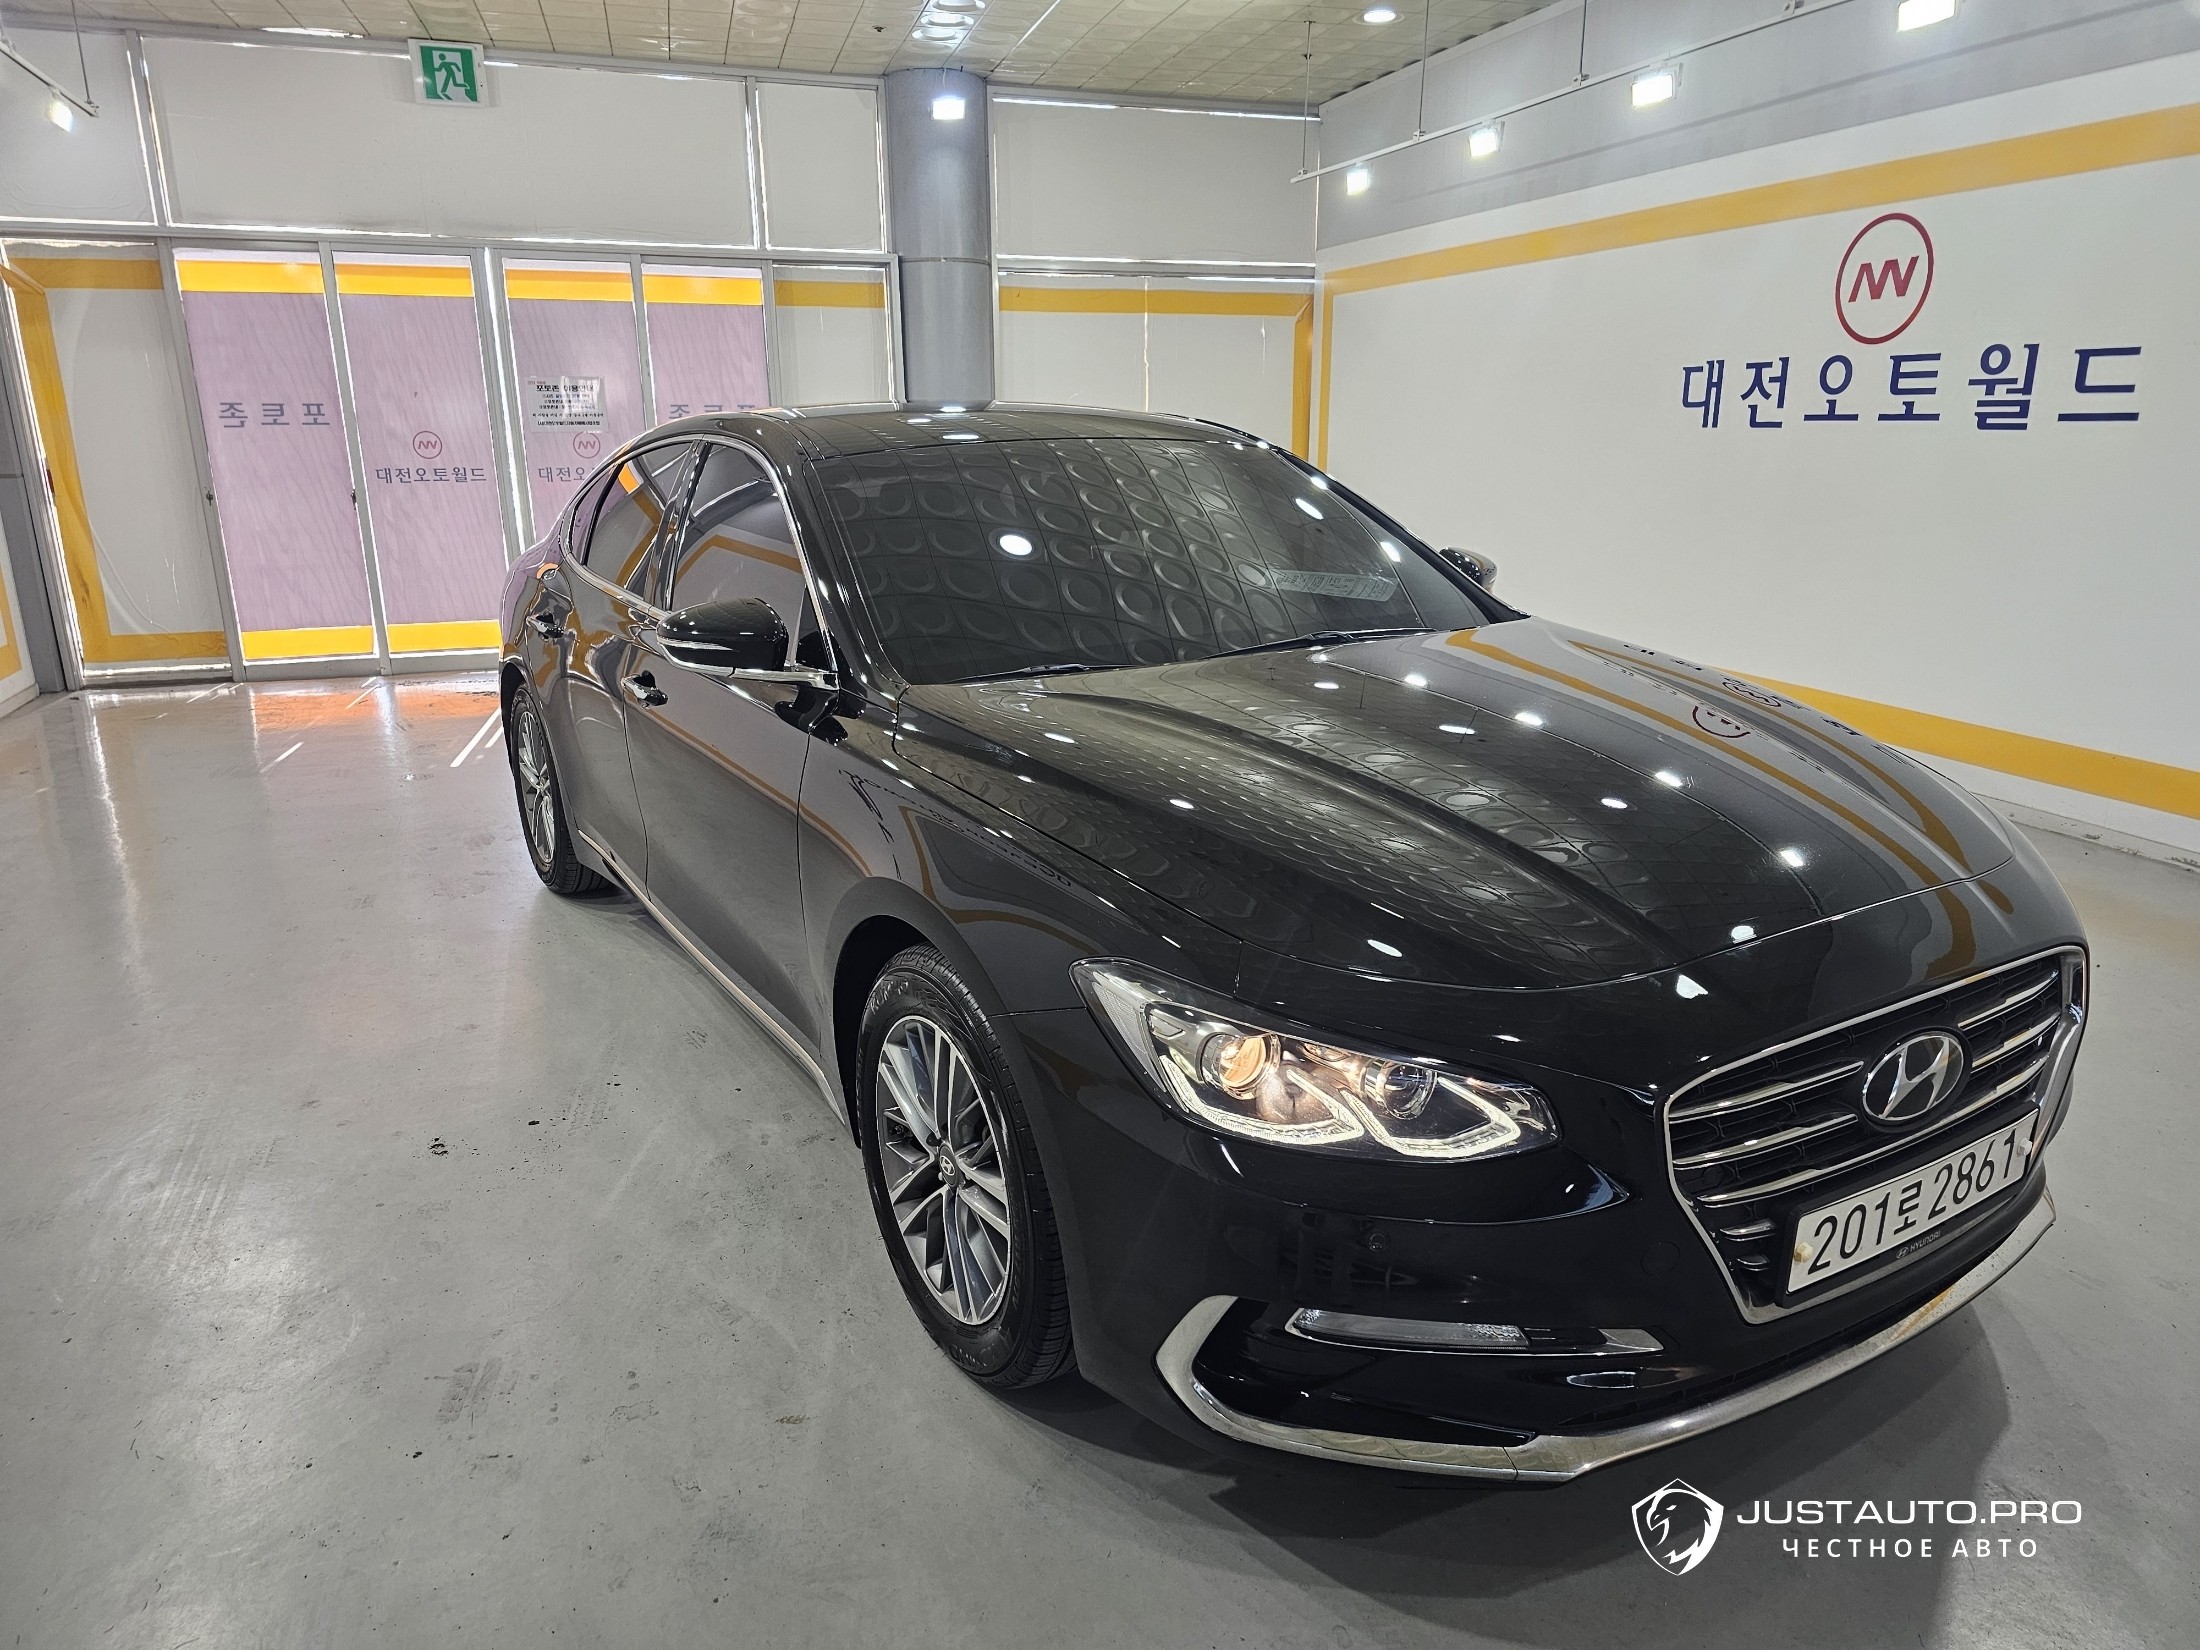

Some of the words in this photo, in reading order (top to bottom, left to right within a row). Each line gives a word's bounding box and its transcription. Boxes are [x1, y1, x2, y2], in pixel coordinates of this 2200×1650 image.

[1681, 343, 2142, 431] 대전오토월드
[375, 466, 488, 485] 대전오토월드
[537, 466, 596, 483] 대전오
[1909, 1229, 1941, 1252] HYUNDAI
